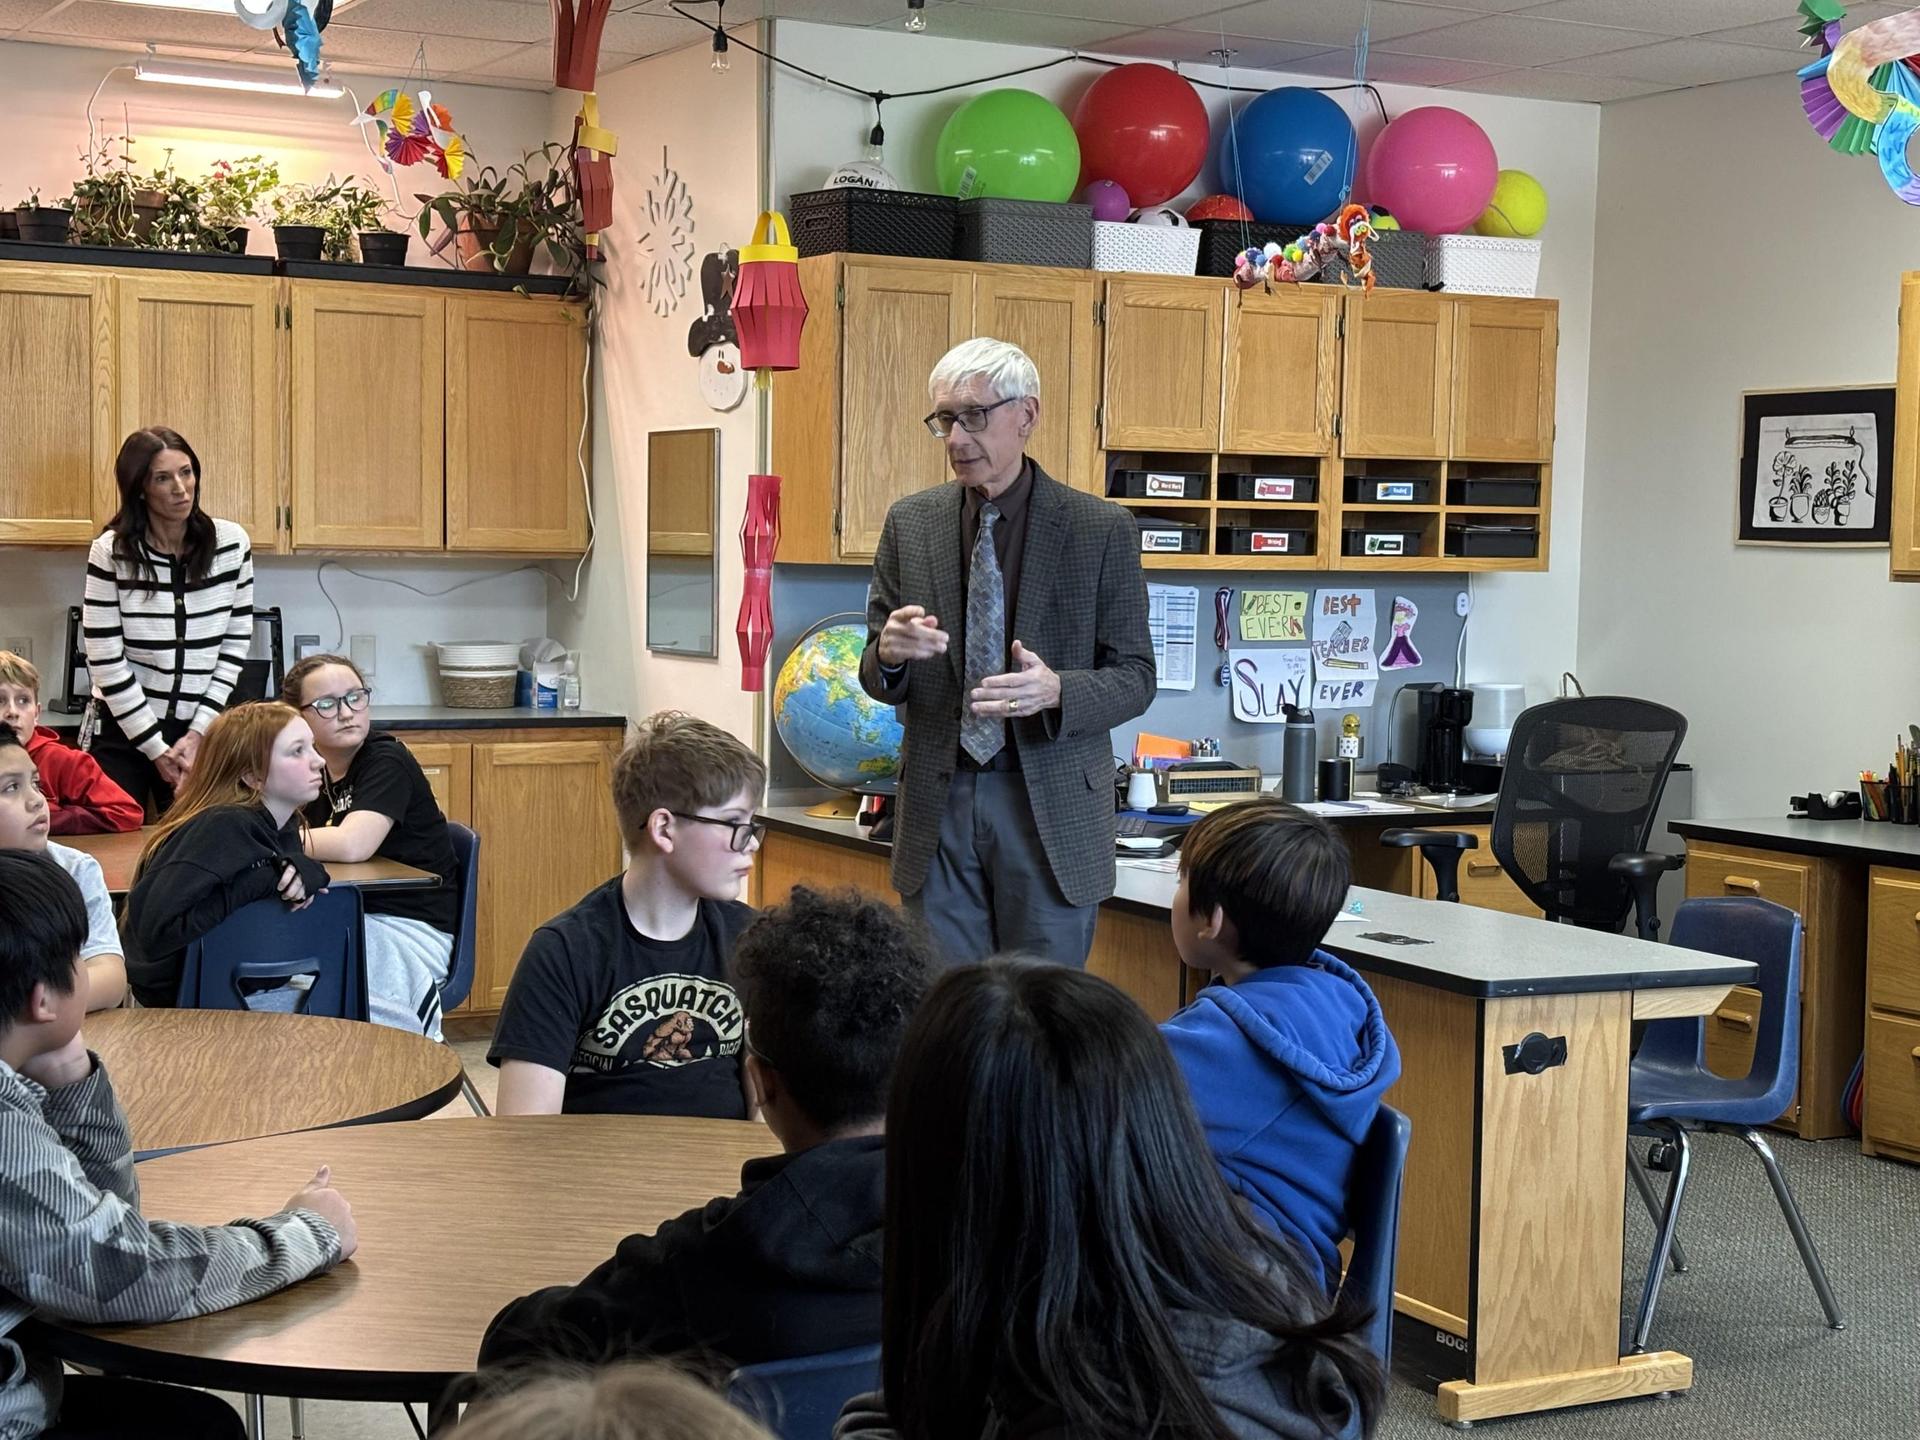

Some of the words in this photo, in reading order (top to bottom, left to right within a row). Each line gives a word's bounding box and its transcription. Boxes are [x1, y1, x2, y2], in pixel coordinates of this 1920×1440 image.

[834, 175, 874, 187] LOGAN
[1256, 594, 1293, 616] BEST
[1323, 593, 1361, 617] BEST
[1246, 616, 1292, 639] EVER
[1312, 636, 1370, 661] TEACHER
[1233, 658, 1304, 717] SLAY
[1320, 681, 1364, 702] EVER
[593, 983, 742, 1049] SASQUATCH
